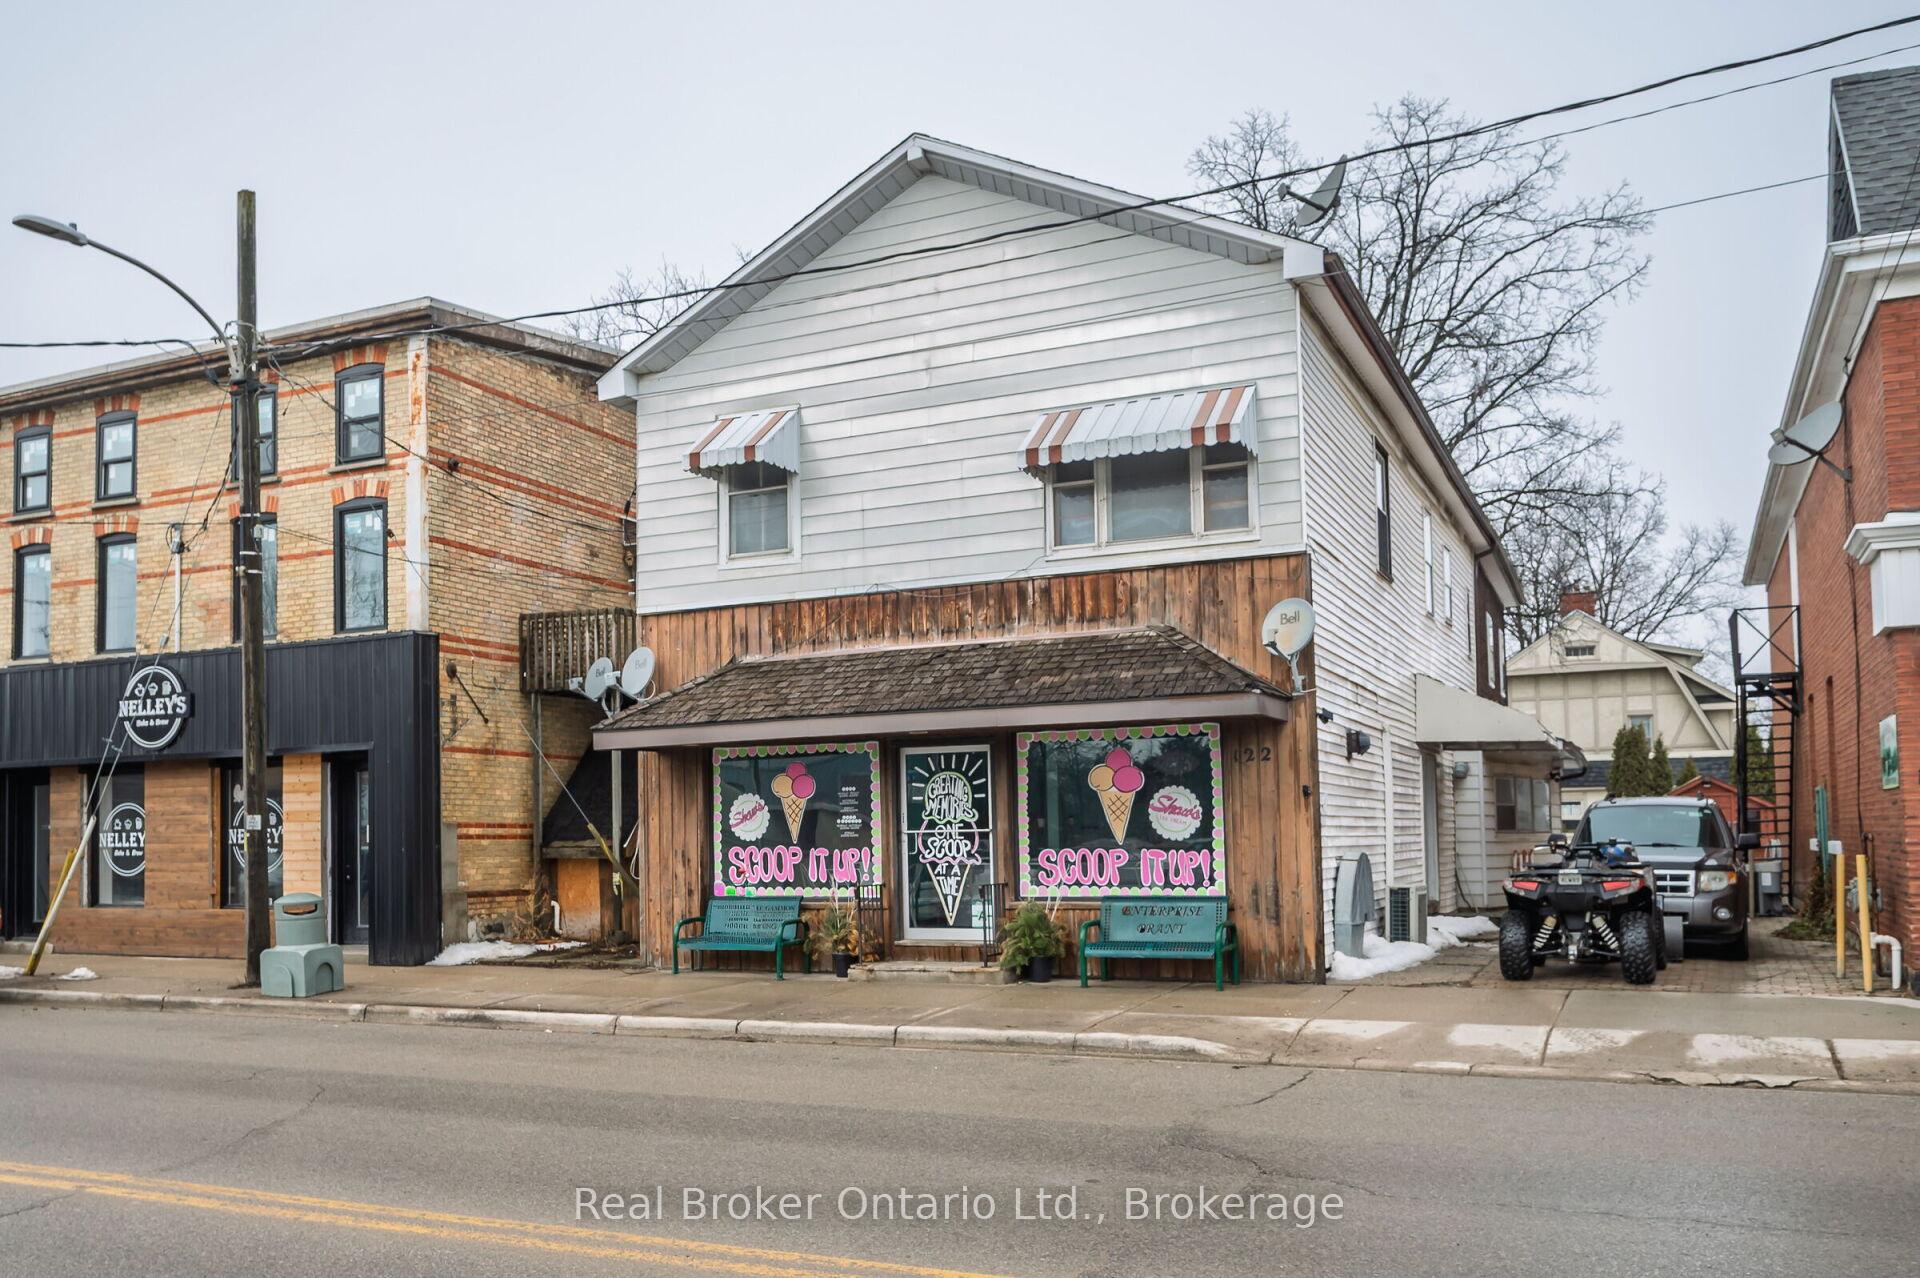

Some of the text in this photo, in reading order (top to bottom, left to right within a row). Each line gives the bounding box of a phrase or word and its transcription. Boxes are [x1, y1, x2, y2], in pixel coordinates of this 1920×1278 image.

[1280, 610, 1300, 625] Bell
[118, 694, 187, 718] NELLEY'S
[929, 774, 968, 802] CREATING
[925, 795, 973, 820] MEMORIES
[1148, 795, 1201, 820] Shaw's
[934, 823, 964, 840] ONE
[924, 836, 971, 858] SCOOP
[728, 844, 870, 886] SCOOP IT UP!
[934, 863, 961, 876] AT A
[1038, 848, 1211, 888] SCOOP IT UP!
[1122, 905, 1204, 917] ENTERPRISE
